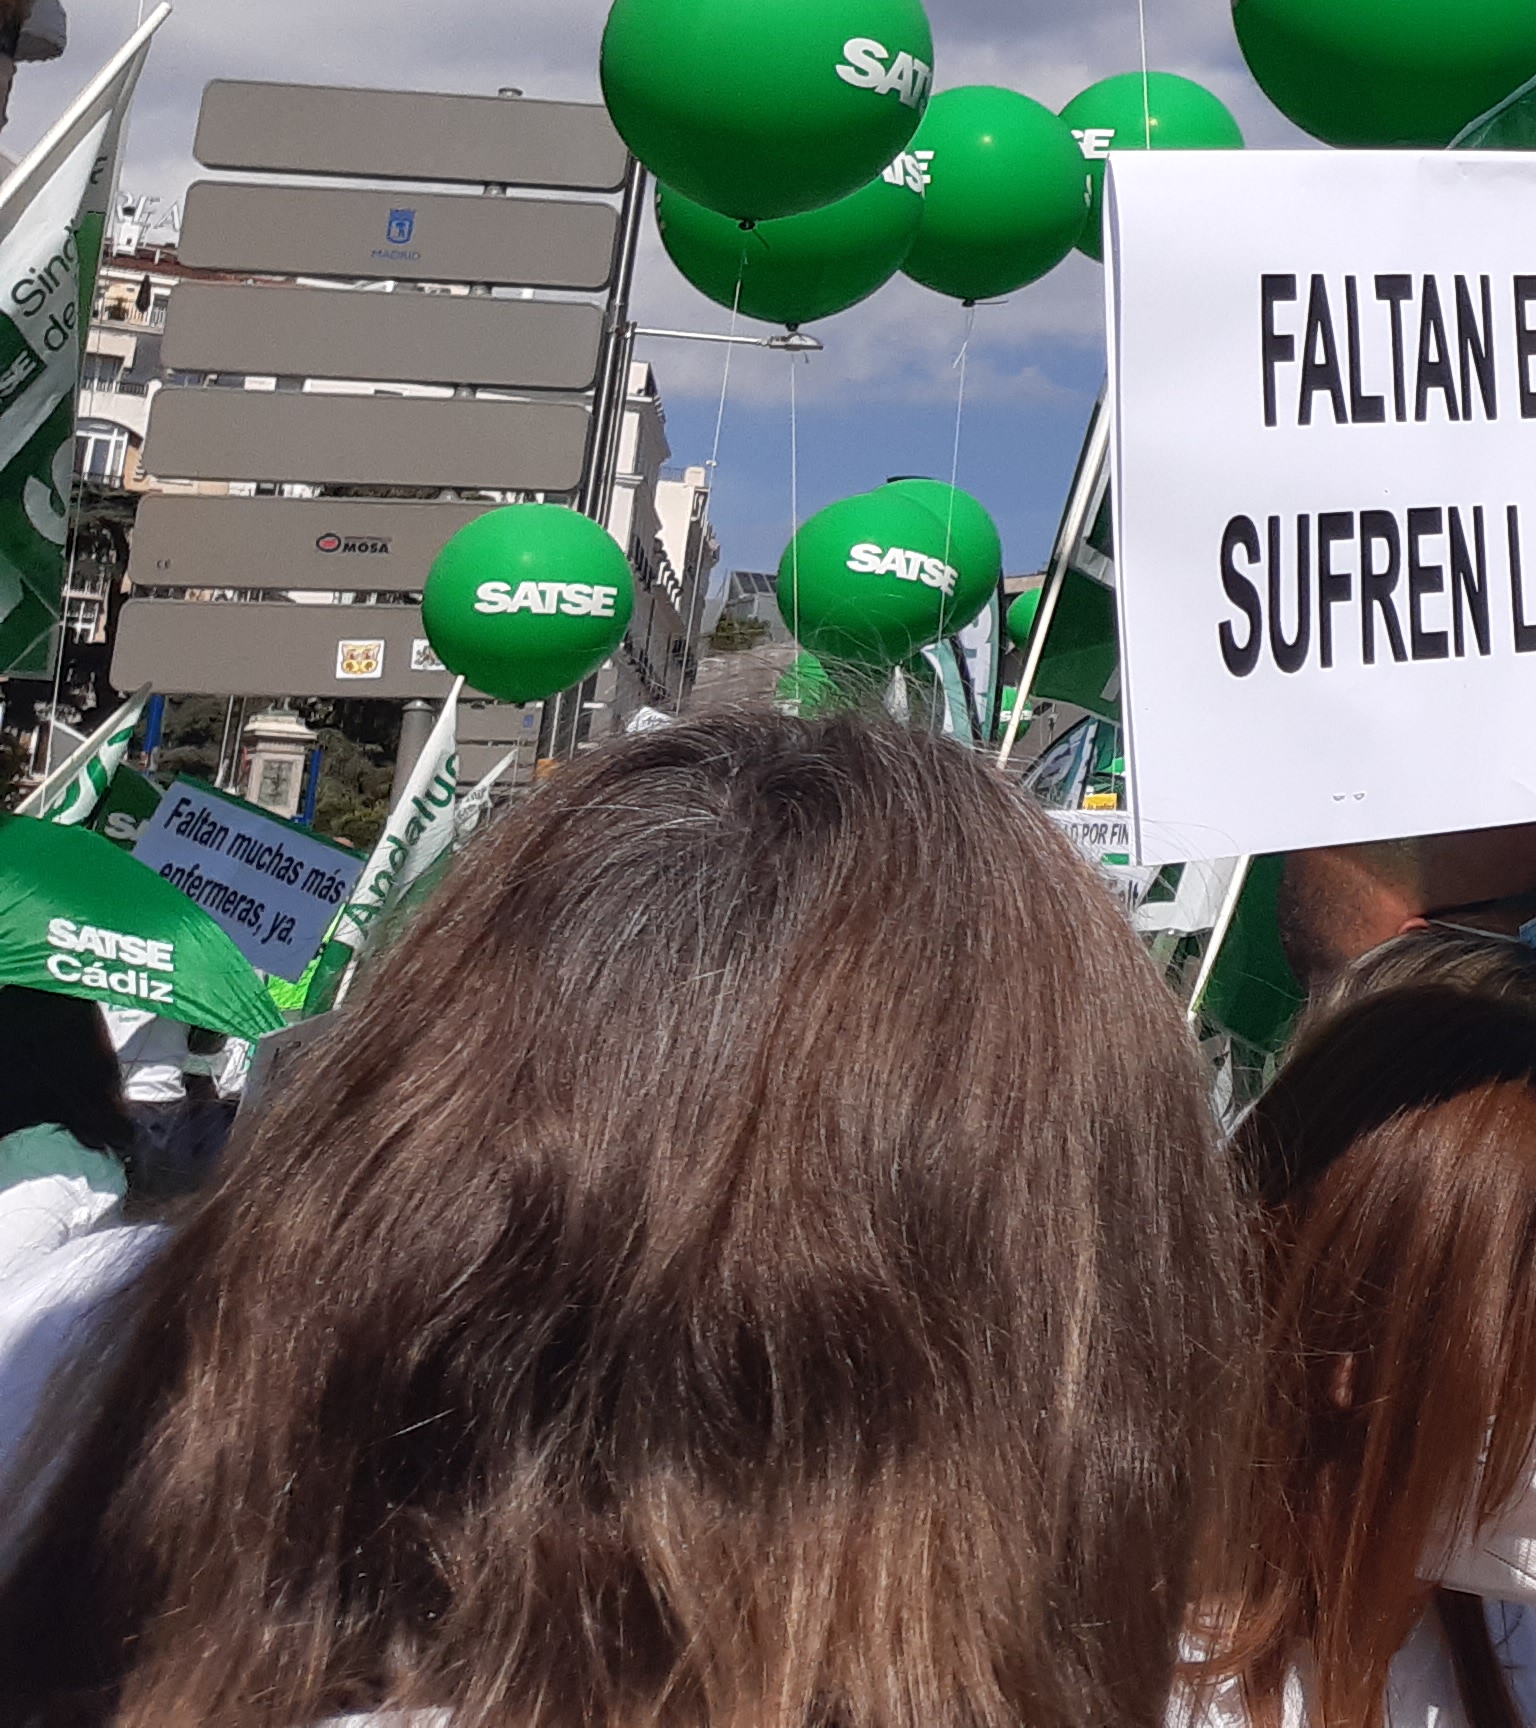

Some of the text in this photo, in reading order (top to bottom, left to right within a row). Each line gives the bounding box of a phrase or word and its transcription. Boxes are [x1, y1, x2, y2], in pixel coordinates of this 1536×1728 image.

[835, 37, 933, 115] SAT
[371, 248, 421, 262] MADRID
[1259, 273, 1498, 429] FALTAN
[342, 541, 391, 554] MOSA
[846, 542, 960, 597] SATSE
[474, 580, 618, 618] SATSE
[1217, 505, 1492, 678] SUFREN
[163, 796, 229, 853] Faltan
[226, 831, 305, 887] muchas
[300, 867, 346, 906] más
[1081, 822, 1109, 846] POR
[158, 861, 297, 947] enfermeras, ya.
[46, 917, 175, 973] SATSE
[46, 953, 175, 1004] Cádiz
